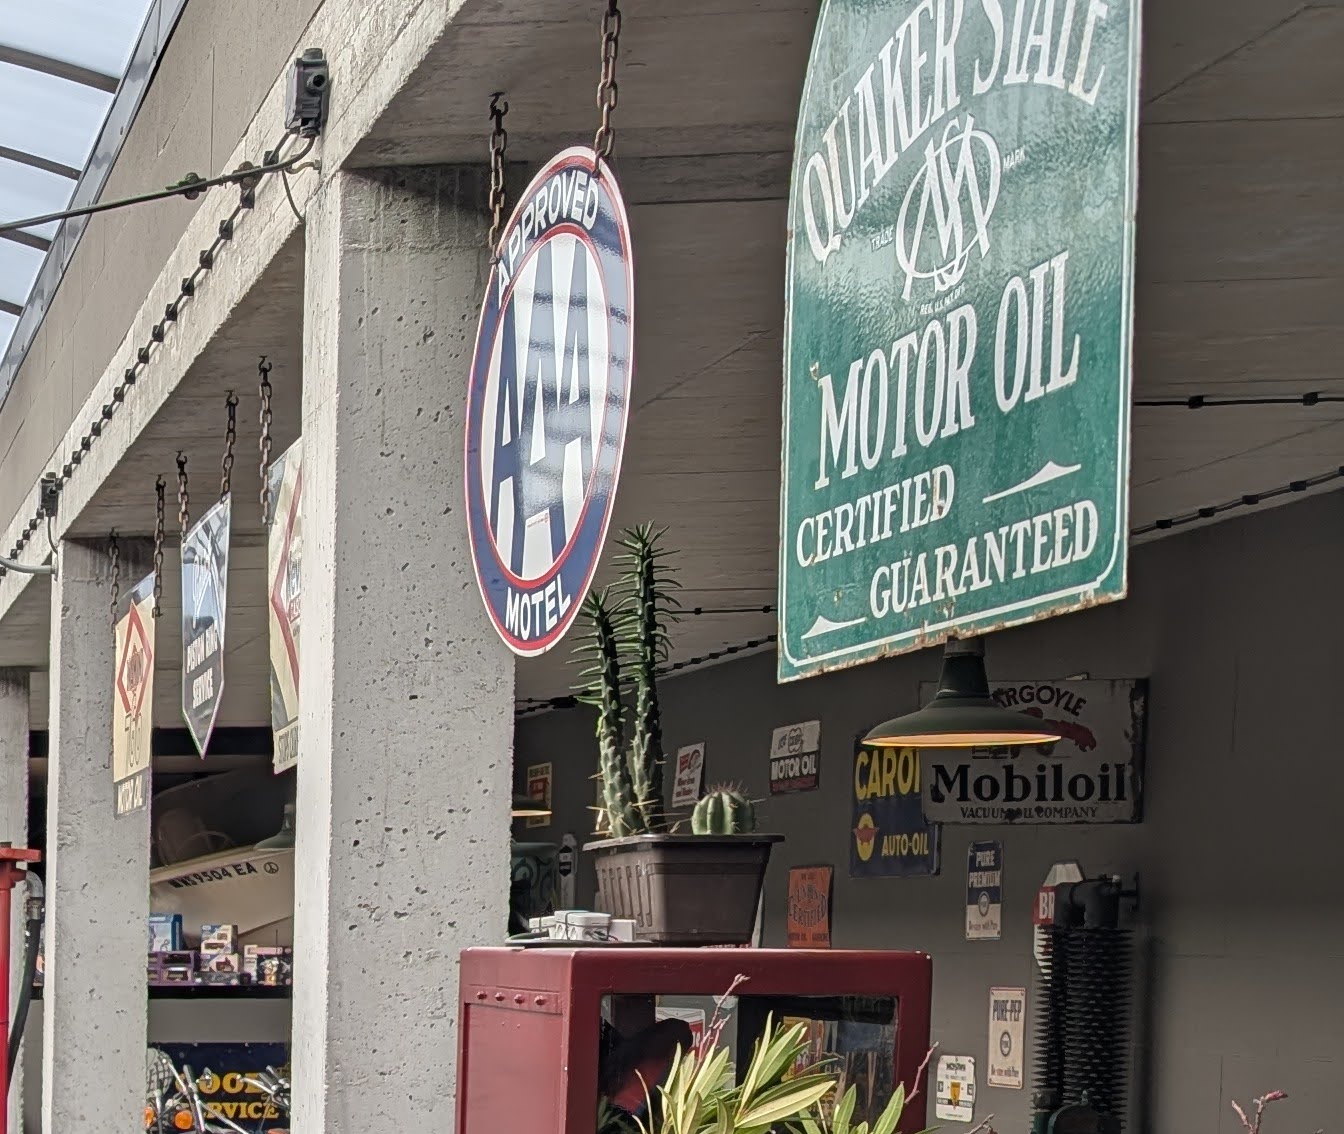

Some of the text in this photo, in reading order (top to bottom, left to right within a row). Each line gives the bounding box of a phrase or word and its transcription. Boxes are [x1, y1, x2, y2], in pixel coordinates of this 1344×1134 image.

[802, 0, 962, 264] QUAKER
[497, 169, 599, 310] APPROVED
[813, 251, 1081, 491] MOTOR OIL
[797, 464, 954, 569] CERTIFIED
[869, 498, 1099, 620] GUARANTEED
[505, 586, 572, 641] MOTEL
[992, 685, 1087, 716] RGOYLE
[771, 754, 817, 781] MOTOR OIL
[931, 763, 1127, 803] Mobiloil
[881, 832, 929, 857] AUTO-OIL
